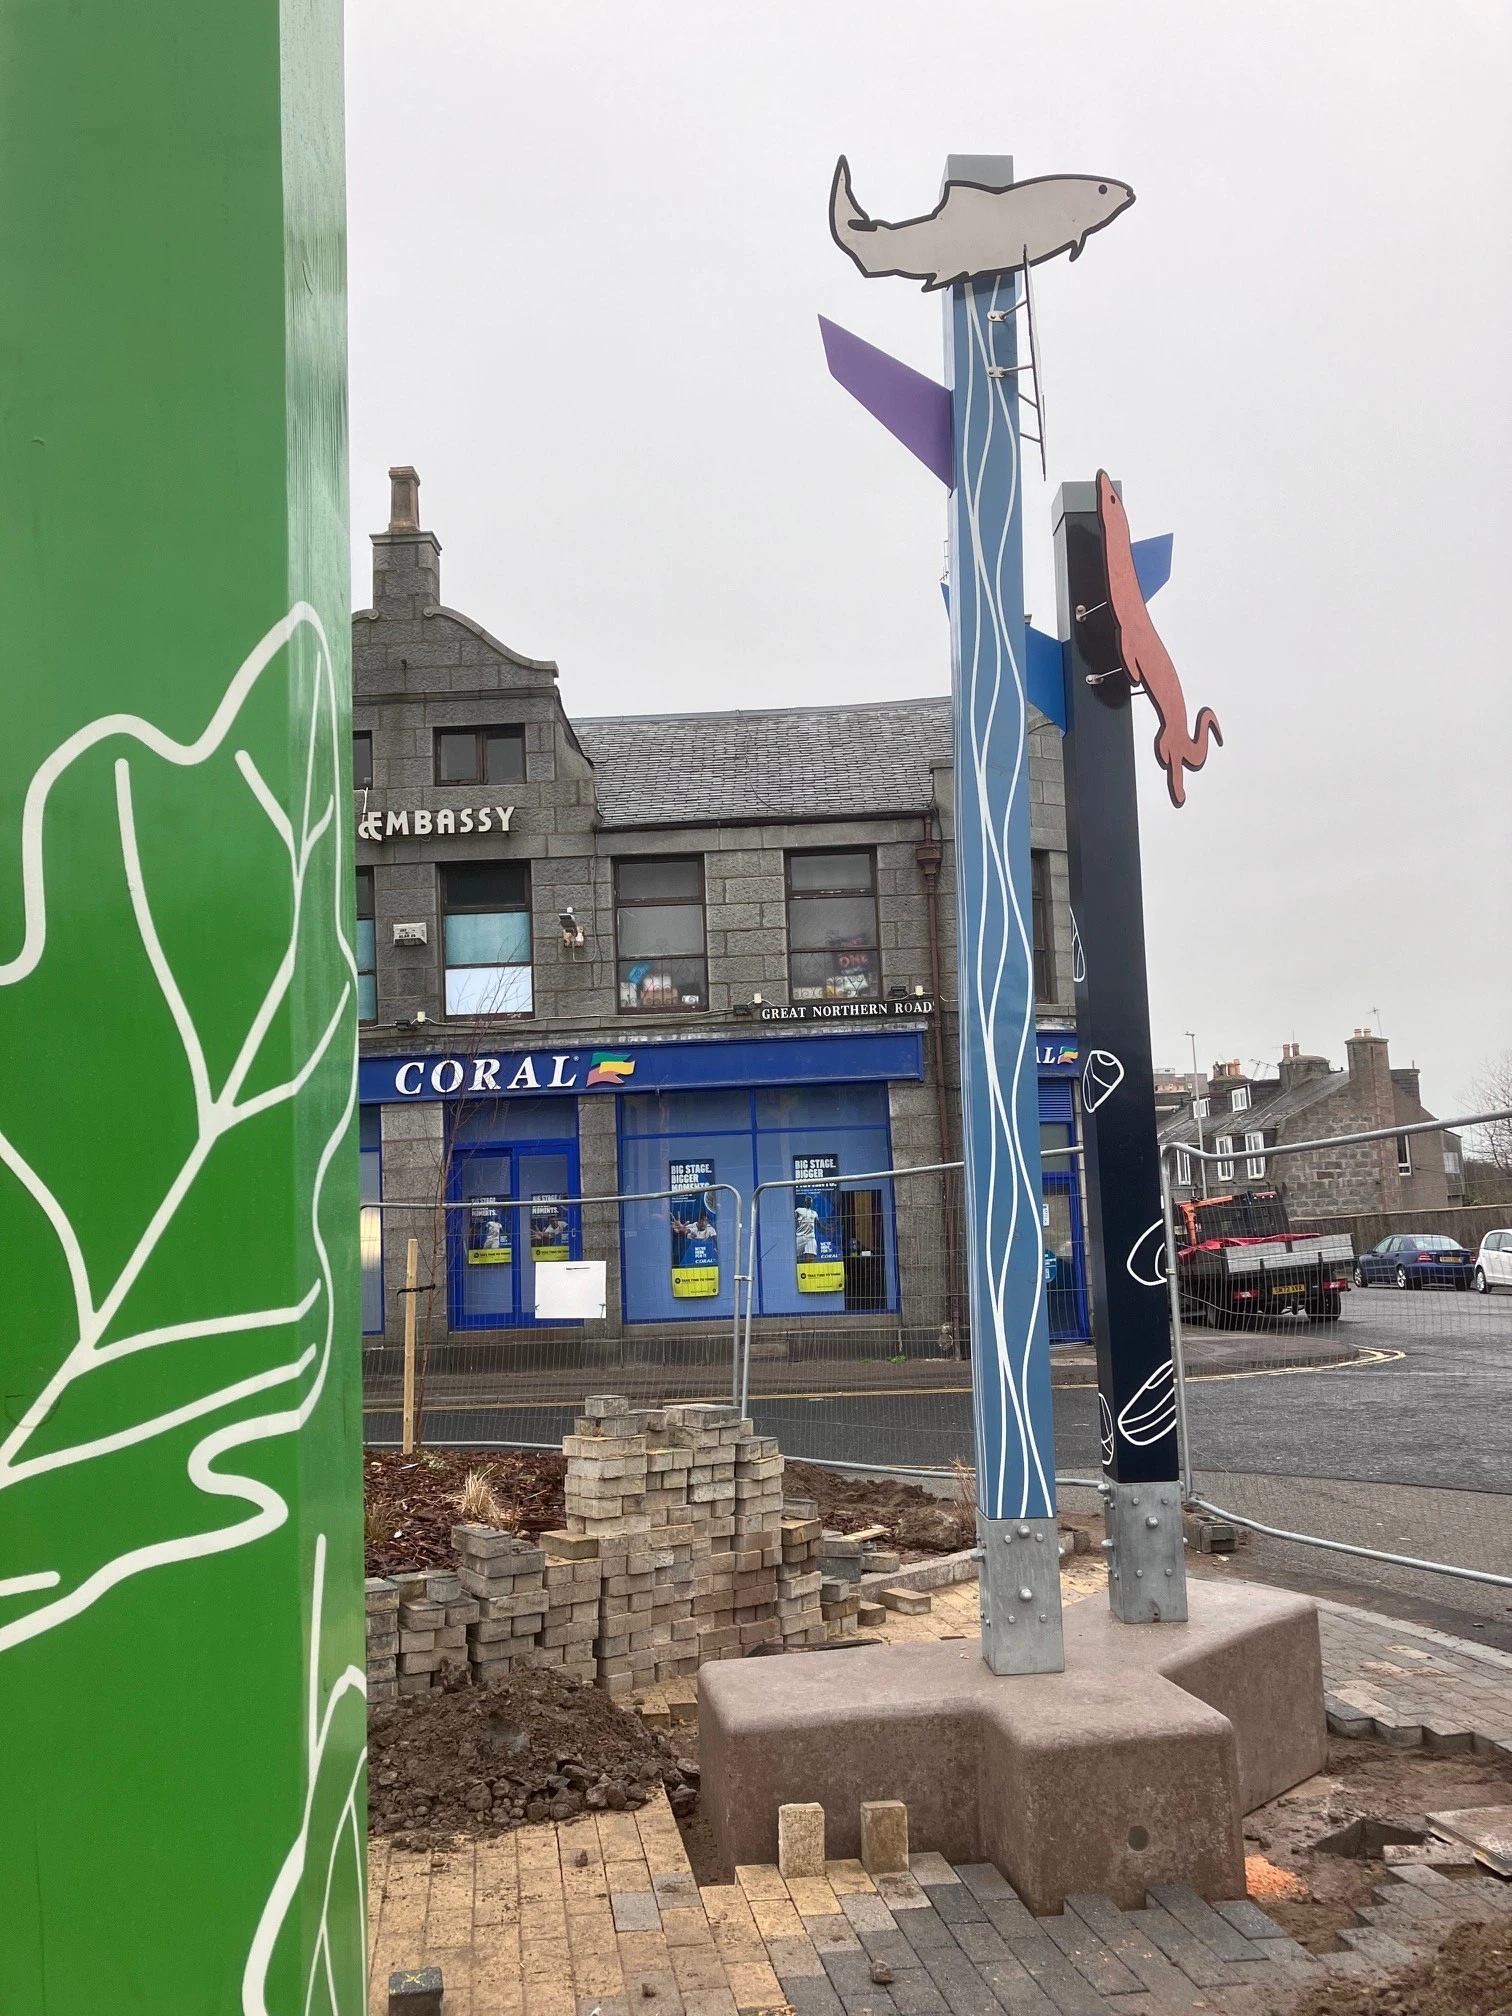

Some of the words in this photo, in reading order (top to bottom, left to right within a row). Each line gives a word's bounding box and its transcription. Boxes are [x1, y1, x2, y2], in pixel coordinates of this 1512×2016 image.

[358, 806, 515, 841] EMBASSY
[761, 1007, 807, 1020] GREAT
[812, 1003, 888, 1018] NORTHERN
[894, 1001, 934, 1015] ROAD
[395, 1056, 578, 1095] CORAL
[671, 1165, 684, 1175] BIG
[685, 1164, 713, 1174] STAGE.
[794, 1160, 809, 1170] BIG
[810, 1159, 837, 1169] STAGE.
[671, 1174, 699, 1184] BIGGER
[795, 1169, 824, 1179] BIGGER
